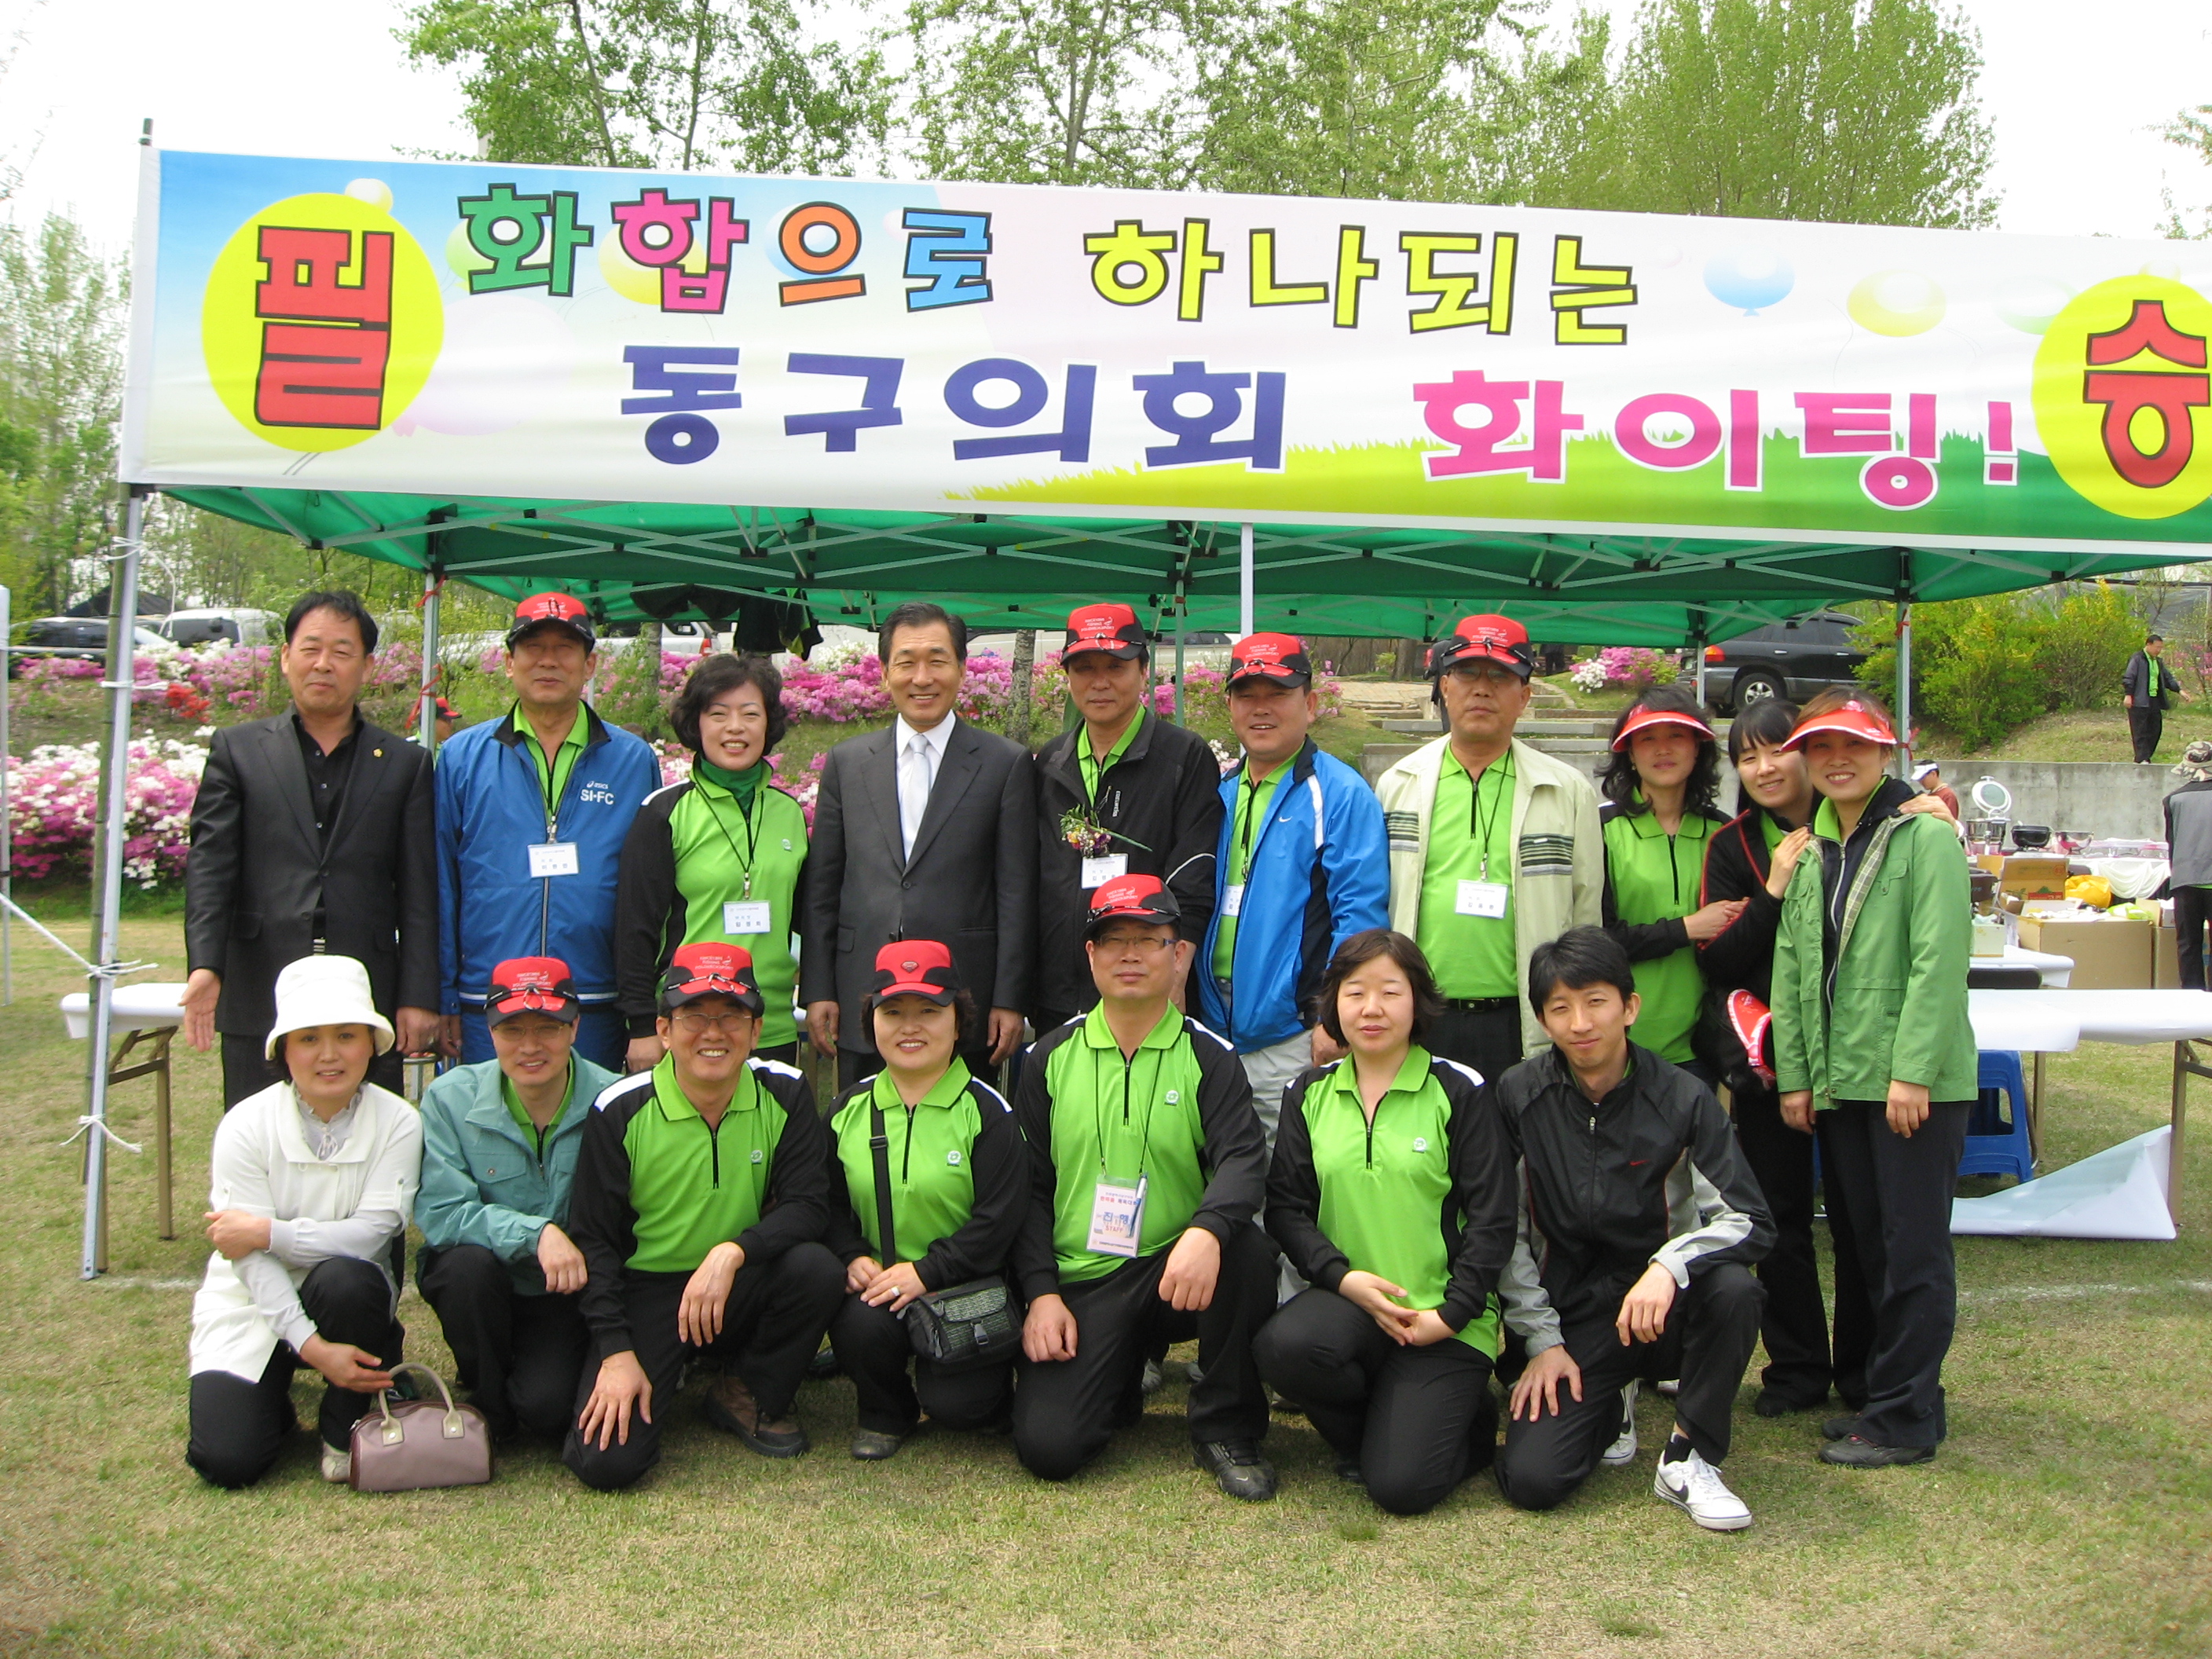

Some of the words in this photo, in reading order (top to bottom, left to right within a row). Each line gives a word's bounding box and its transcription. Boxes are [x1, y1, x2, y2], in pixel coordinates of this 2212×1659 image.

[255, 225, 395, 430] 필
[457, 182, 994, 314] 화합으로
[1083, 218, 1638, 346] 하나되는
[621, 345, 1286, 470] 동구의회
[1413, 369, 2016, 508] 화이팅!
[2083, 299, 2211, 489] 승
